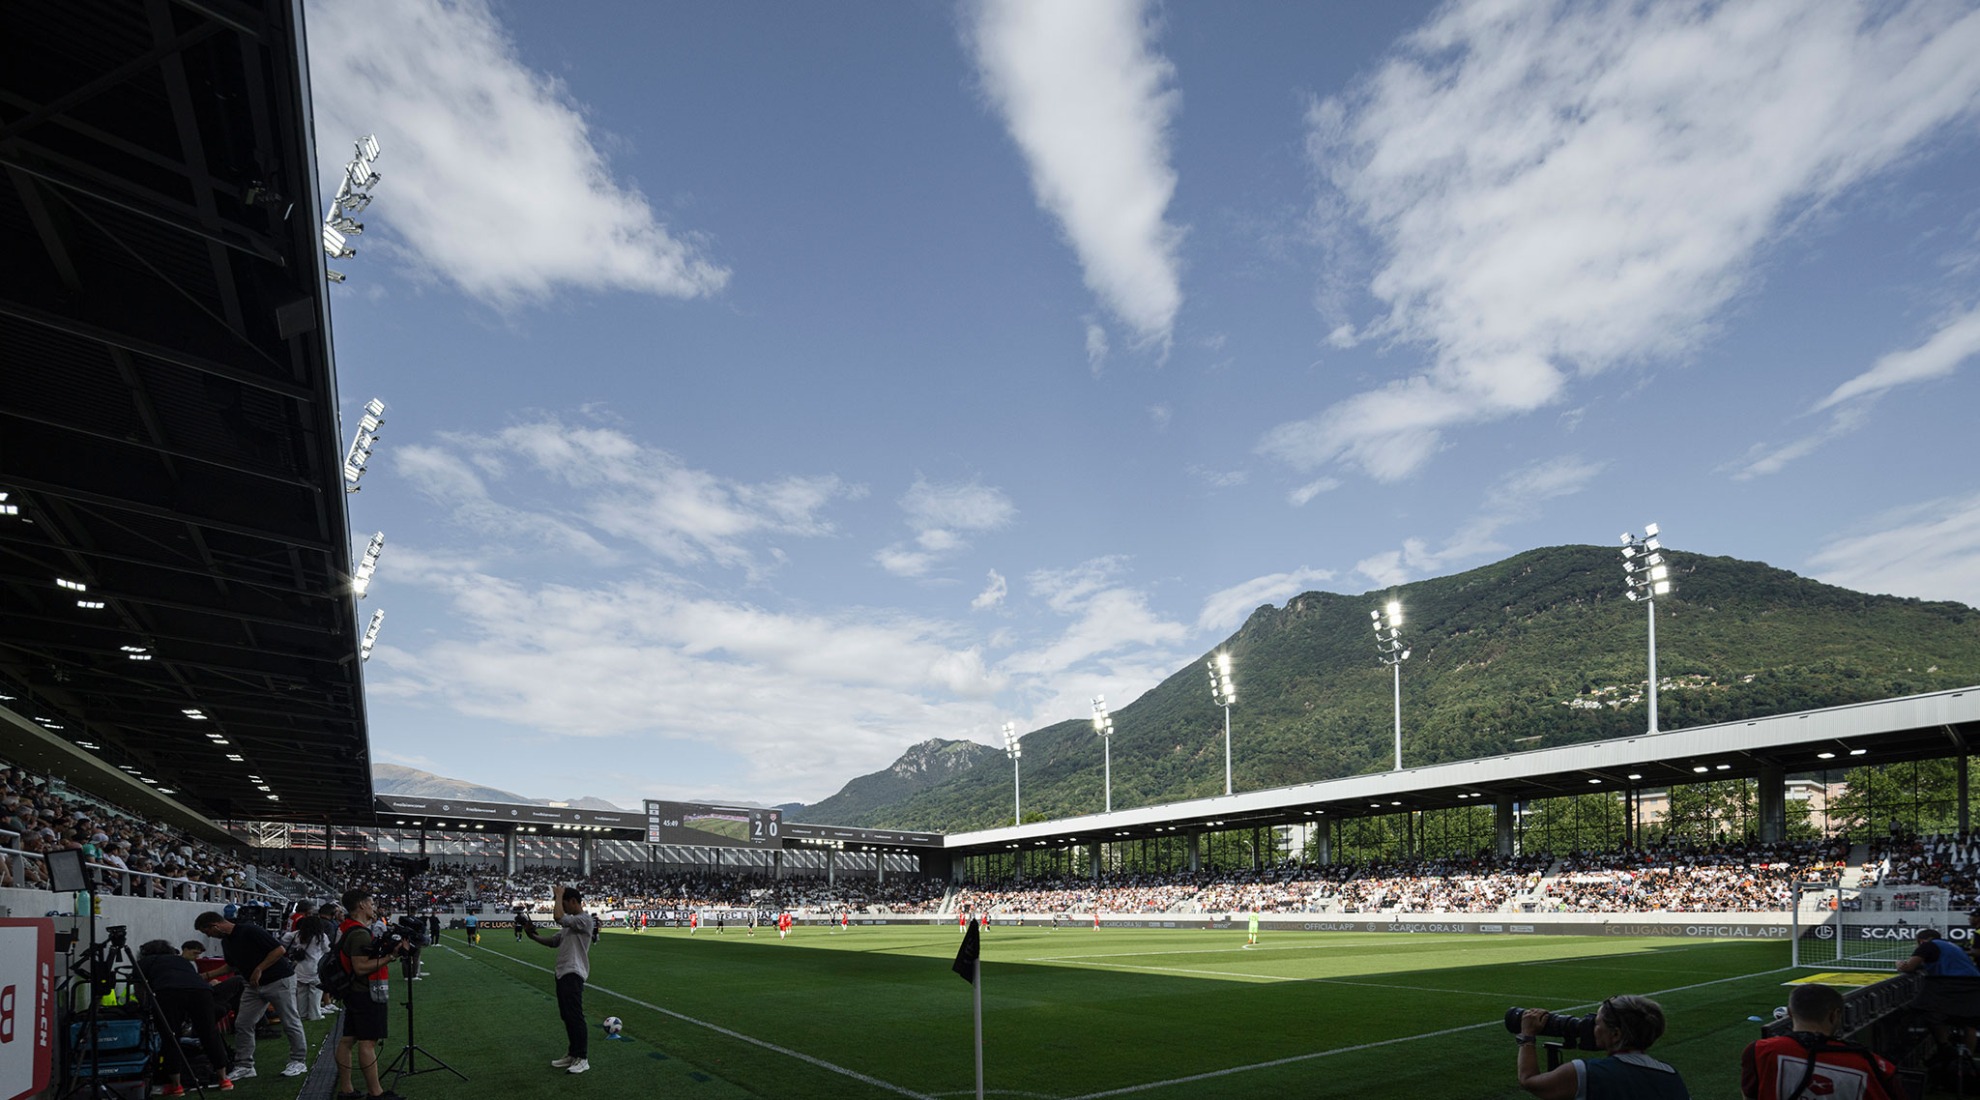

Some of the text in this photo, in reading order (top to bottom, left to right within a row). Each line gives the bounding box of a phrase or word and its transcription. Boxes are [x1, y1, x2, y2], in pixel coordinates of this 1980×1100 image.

[755, 821, 763, 836] 2
[769, 822, 778, 837] 0
[1304, 922, 1337, 931] OFFICIAL
[1339, 923, 1355, 931] APP
[1388, 923, 1465, 933] SCARICA ORA SU
[1605, 926, 1788, 937] FC LUGANO OFFICIAL APP
[1861, 928, 1926, 940] SCARI
[40, 962, 50, 1048] SFL.CH
